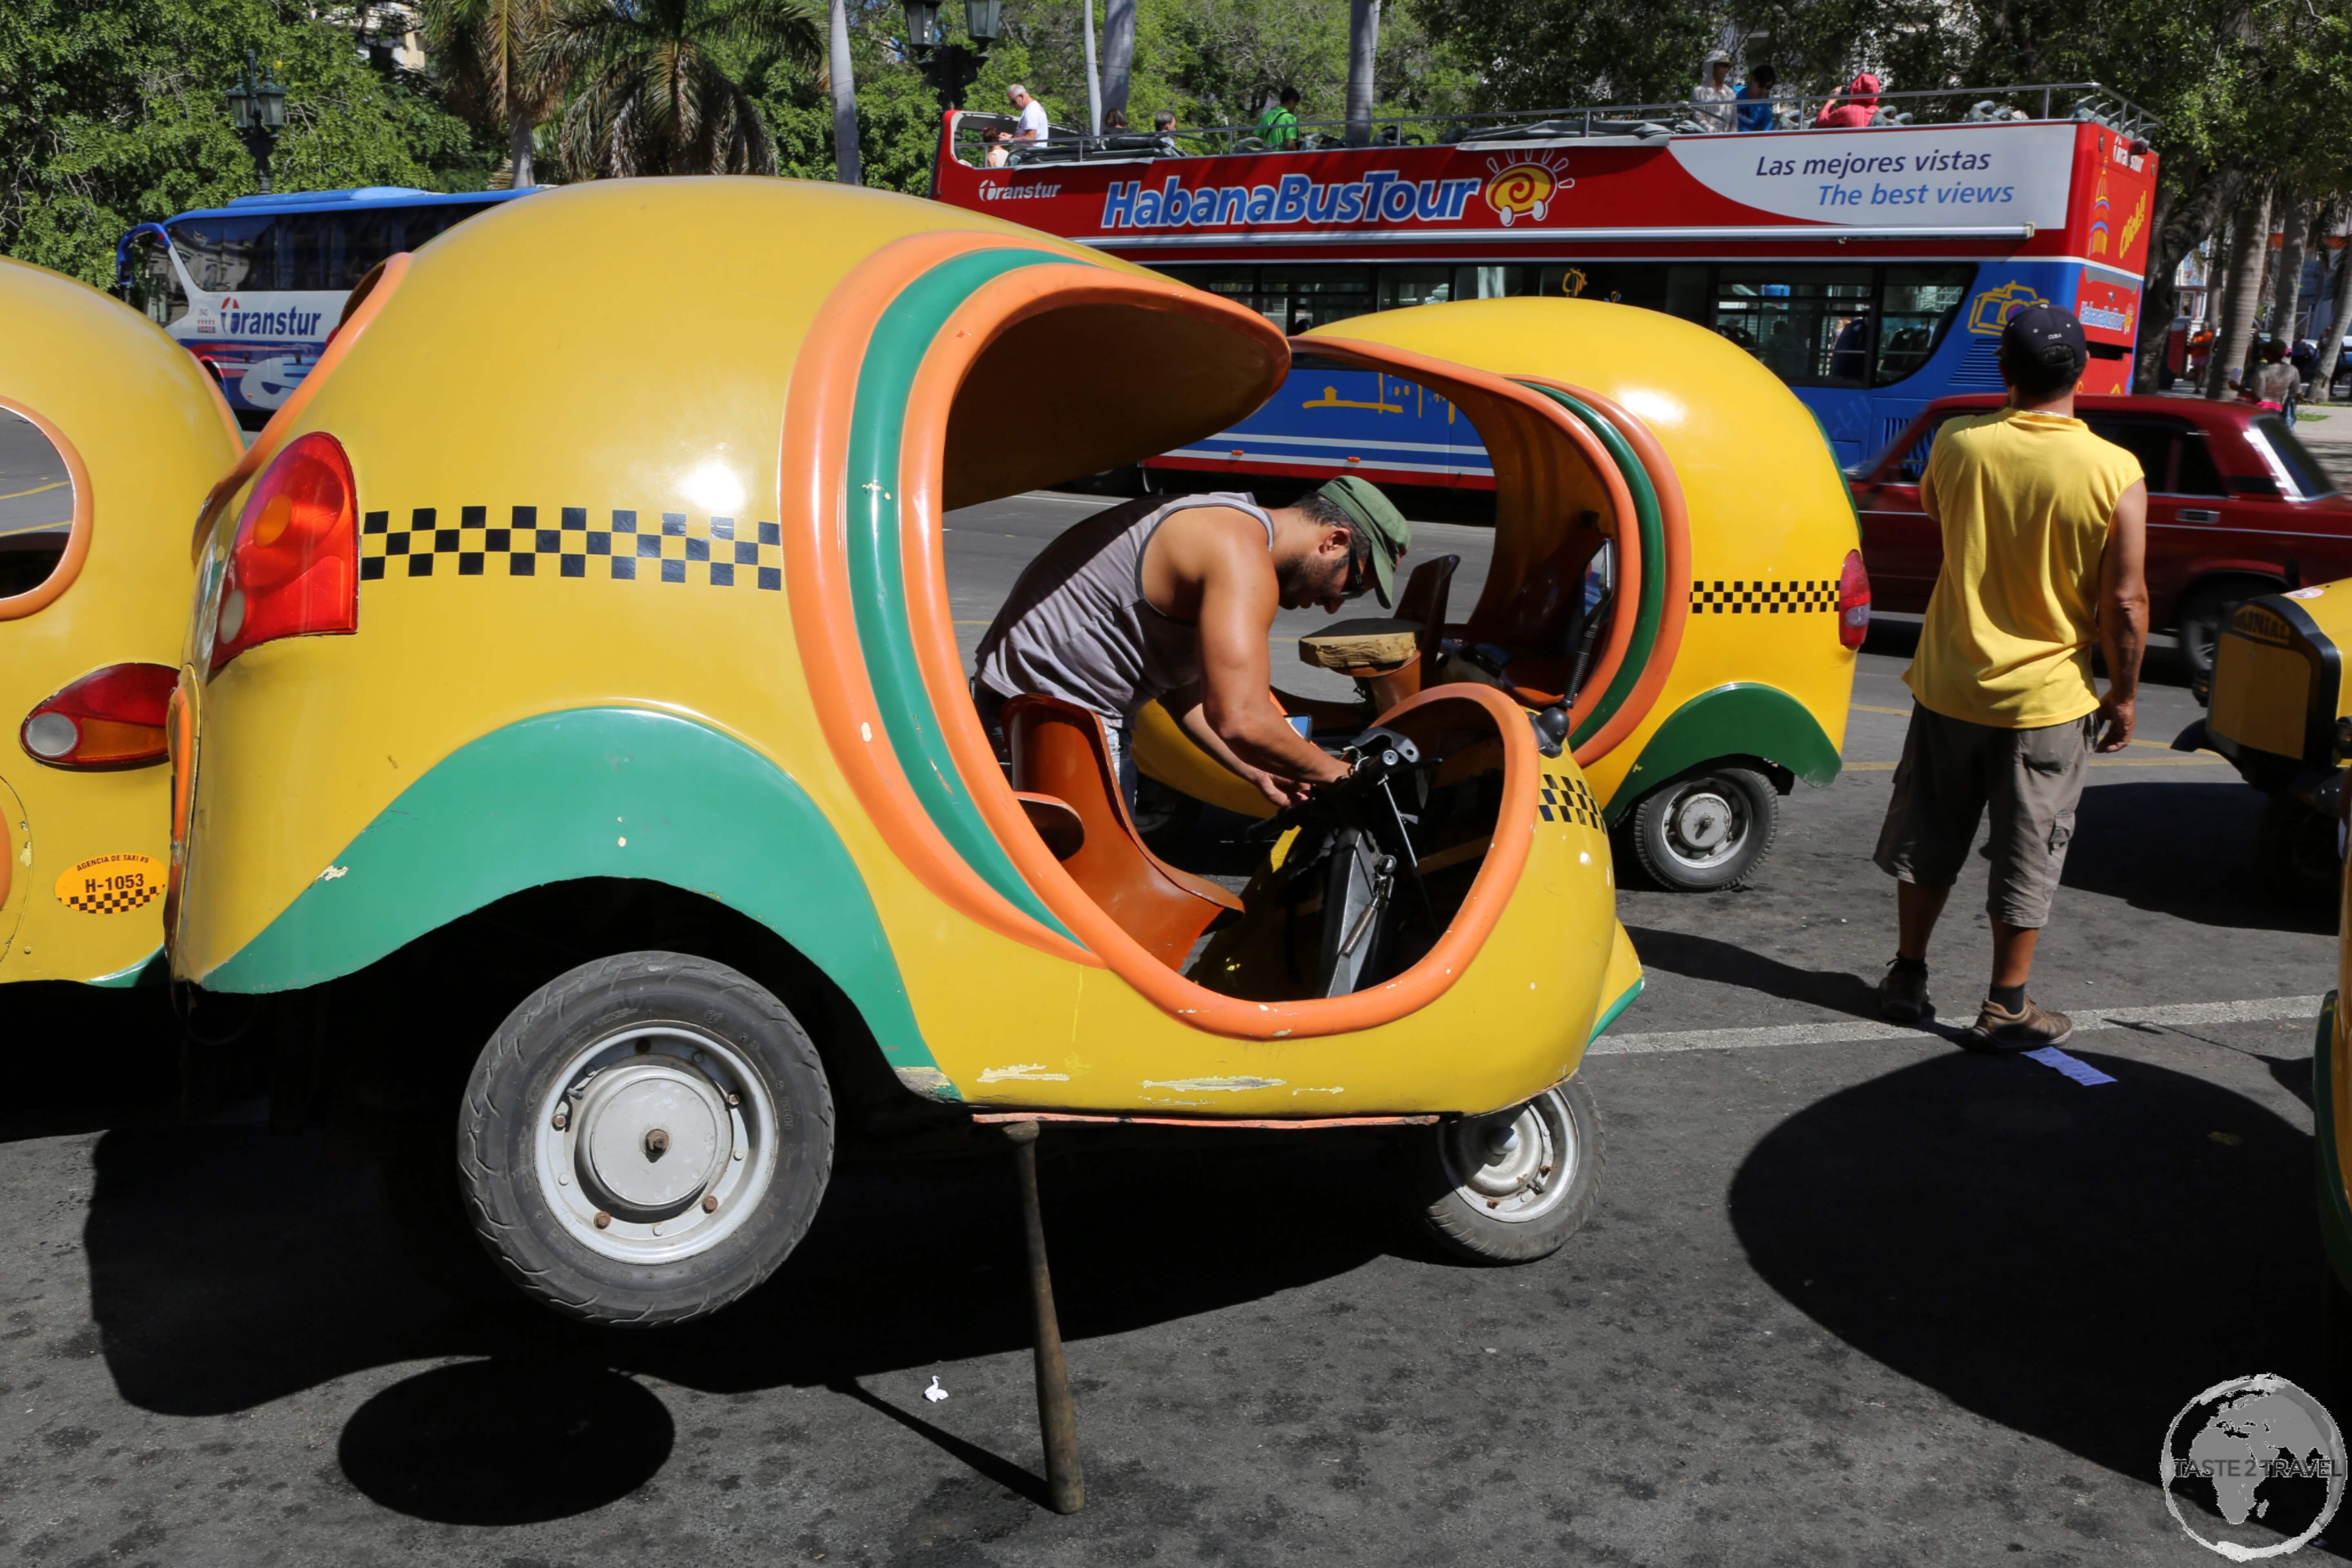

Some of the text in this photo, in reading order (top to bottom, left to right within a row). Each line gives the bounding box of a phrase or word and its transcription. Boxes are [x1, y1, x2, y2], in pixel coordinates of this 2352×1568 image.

[1756, 149, 1991, 179] Las mejores vistas
[1100, 169, 1482, 228] HabanaBusTour
[1819, 181, 2014, 205] The best views
[76, 856, 109, 871] AGENCIA
[85, 873, 144, 893] H-1053
